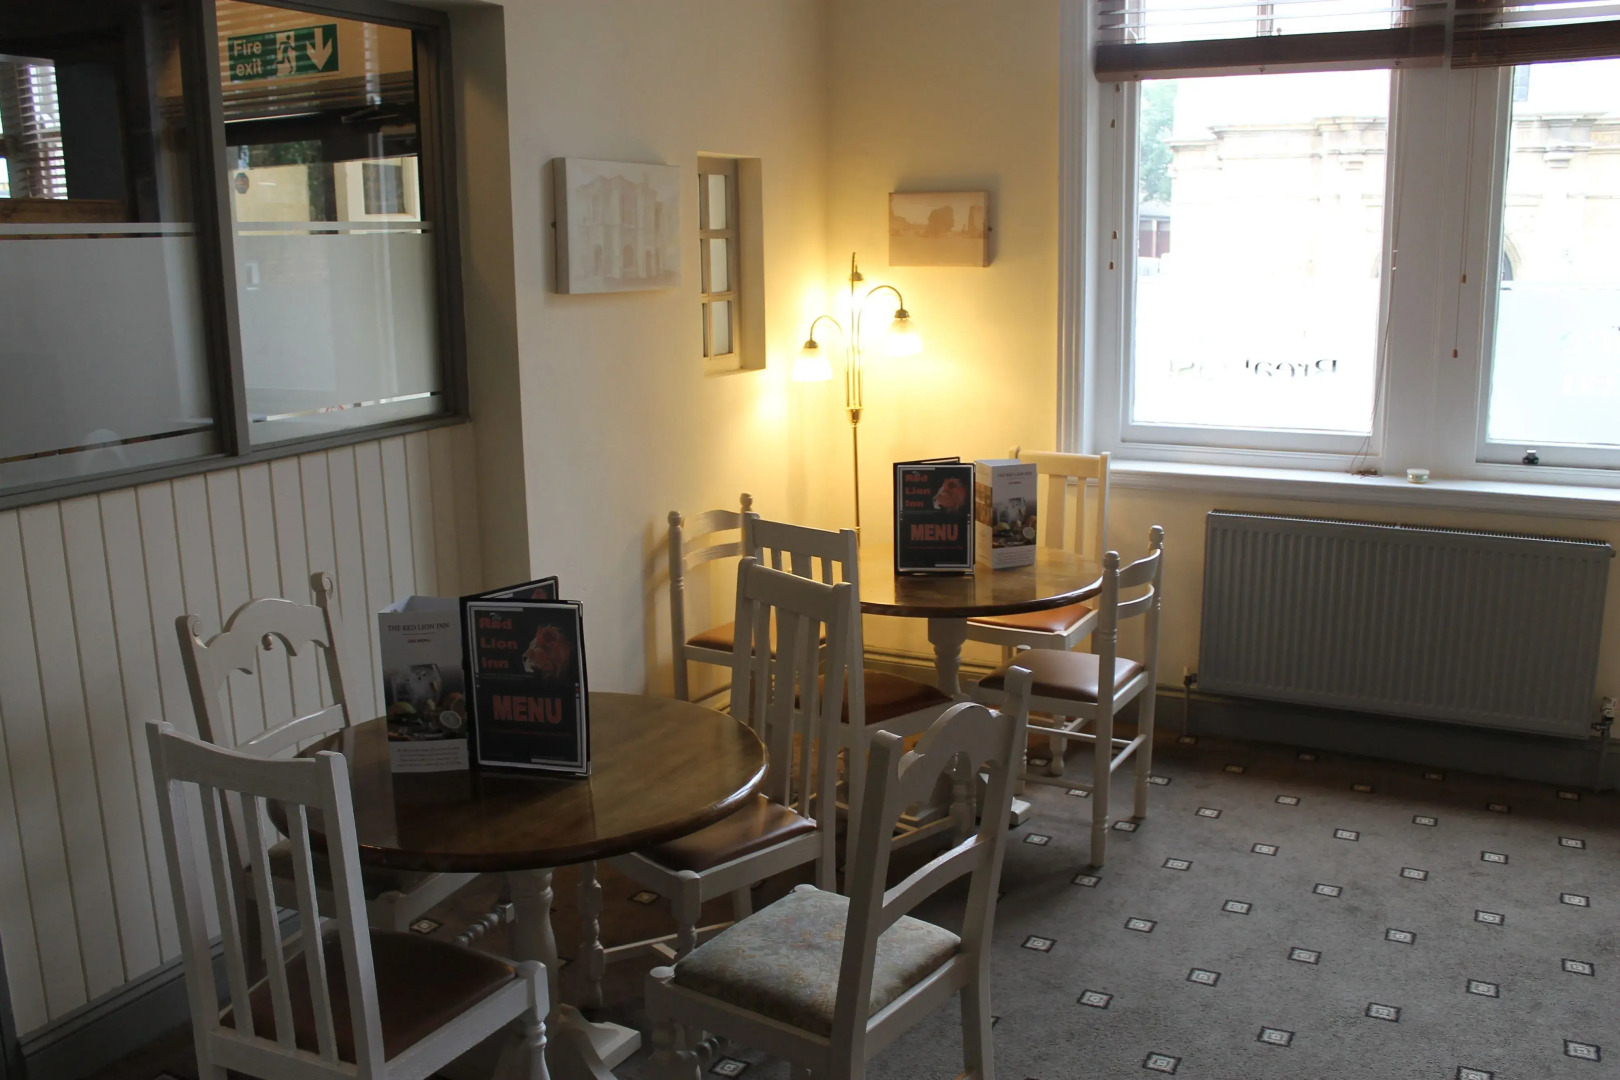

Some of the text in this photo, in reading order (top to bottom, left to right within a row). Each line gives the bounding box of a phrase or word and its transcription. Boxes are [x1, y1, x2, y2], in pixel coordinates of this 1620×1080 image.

[233, 39, 262, 57] Fire
[235, 58, 262, 77] exit
[905, 474, 928, 482] Red
[905, 487, 932, 495] Lion
[905, 499, 925, 507] Inn
[910, 523, 959, 541] MENU
[387, 624, 400, 632] THE
[417, 623, 435, 631] LION
[436, 622, 450, 630] INN
[479, 616, 513, 630] Red
[480, 636, 519, 650] Lion
[481, 655, 510, 669] Inn
[492, 694, 563, 725] MENU
